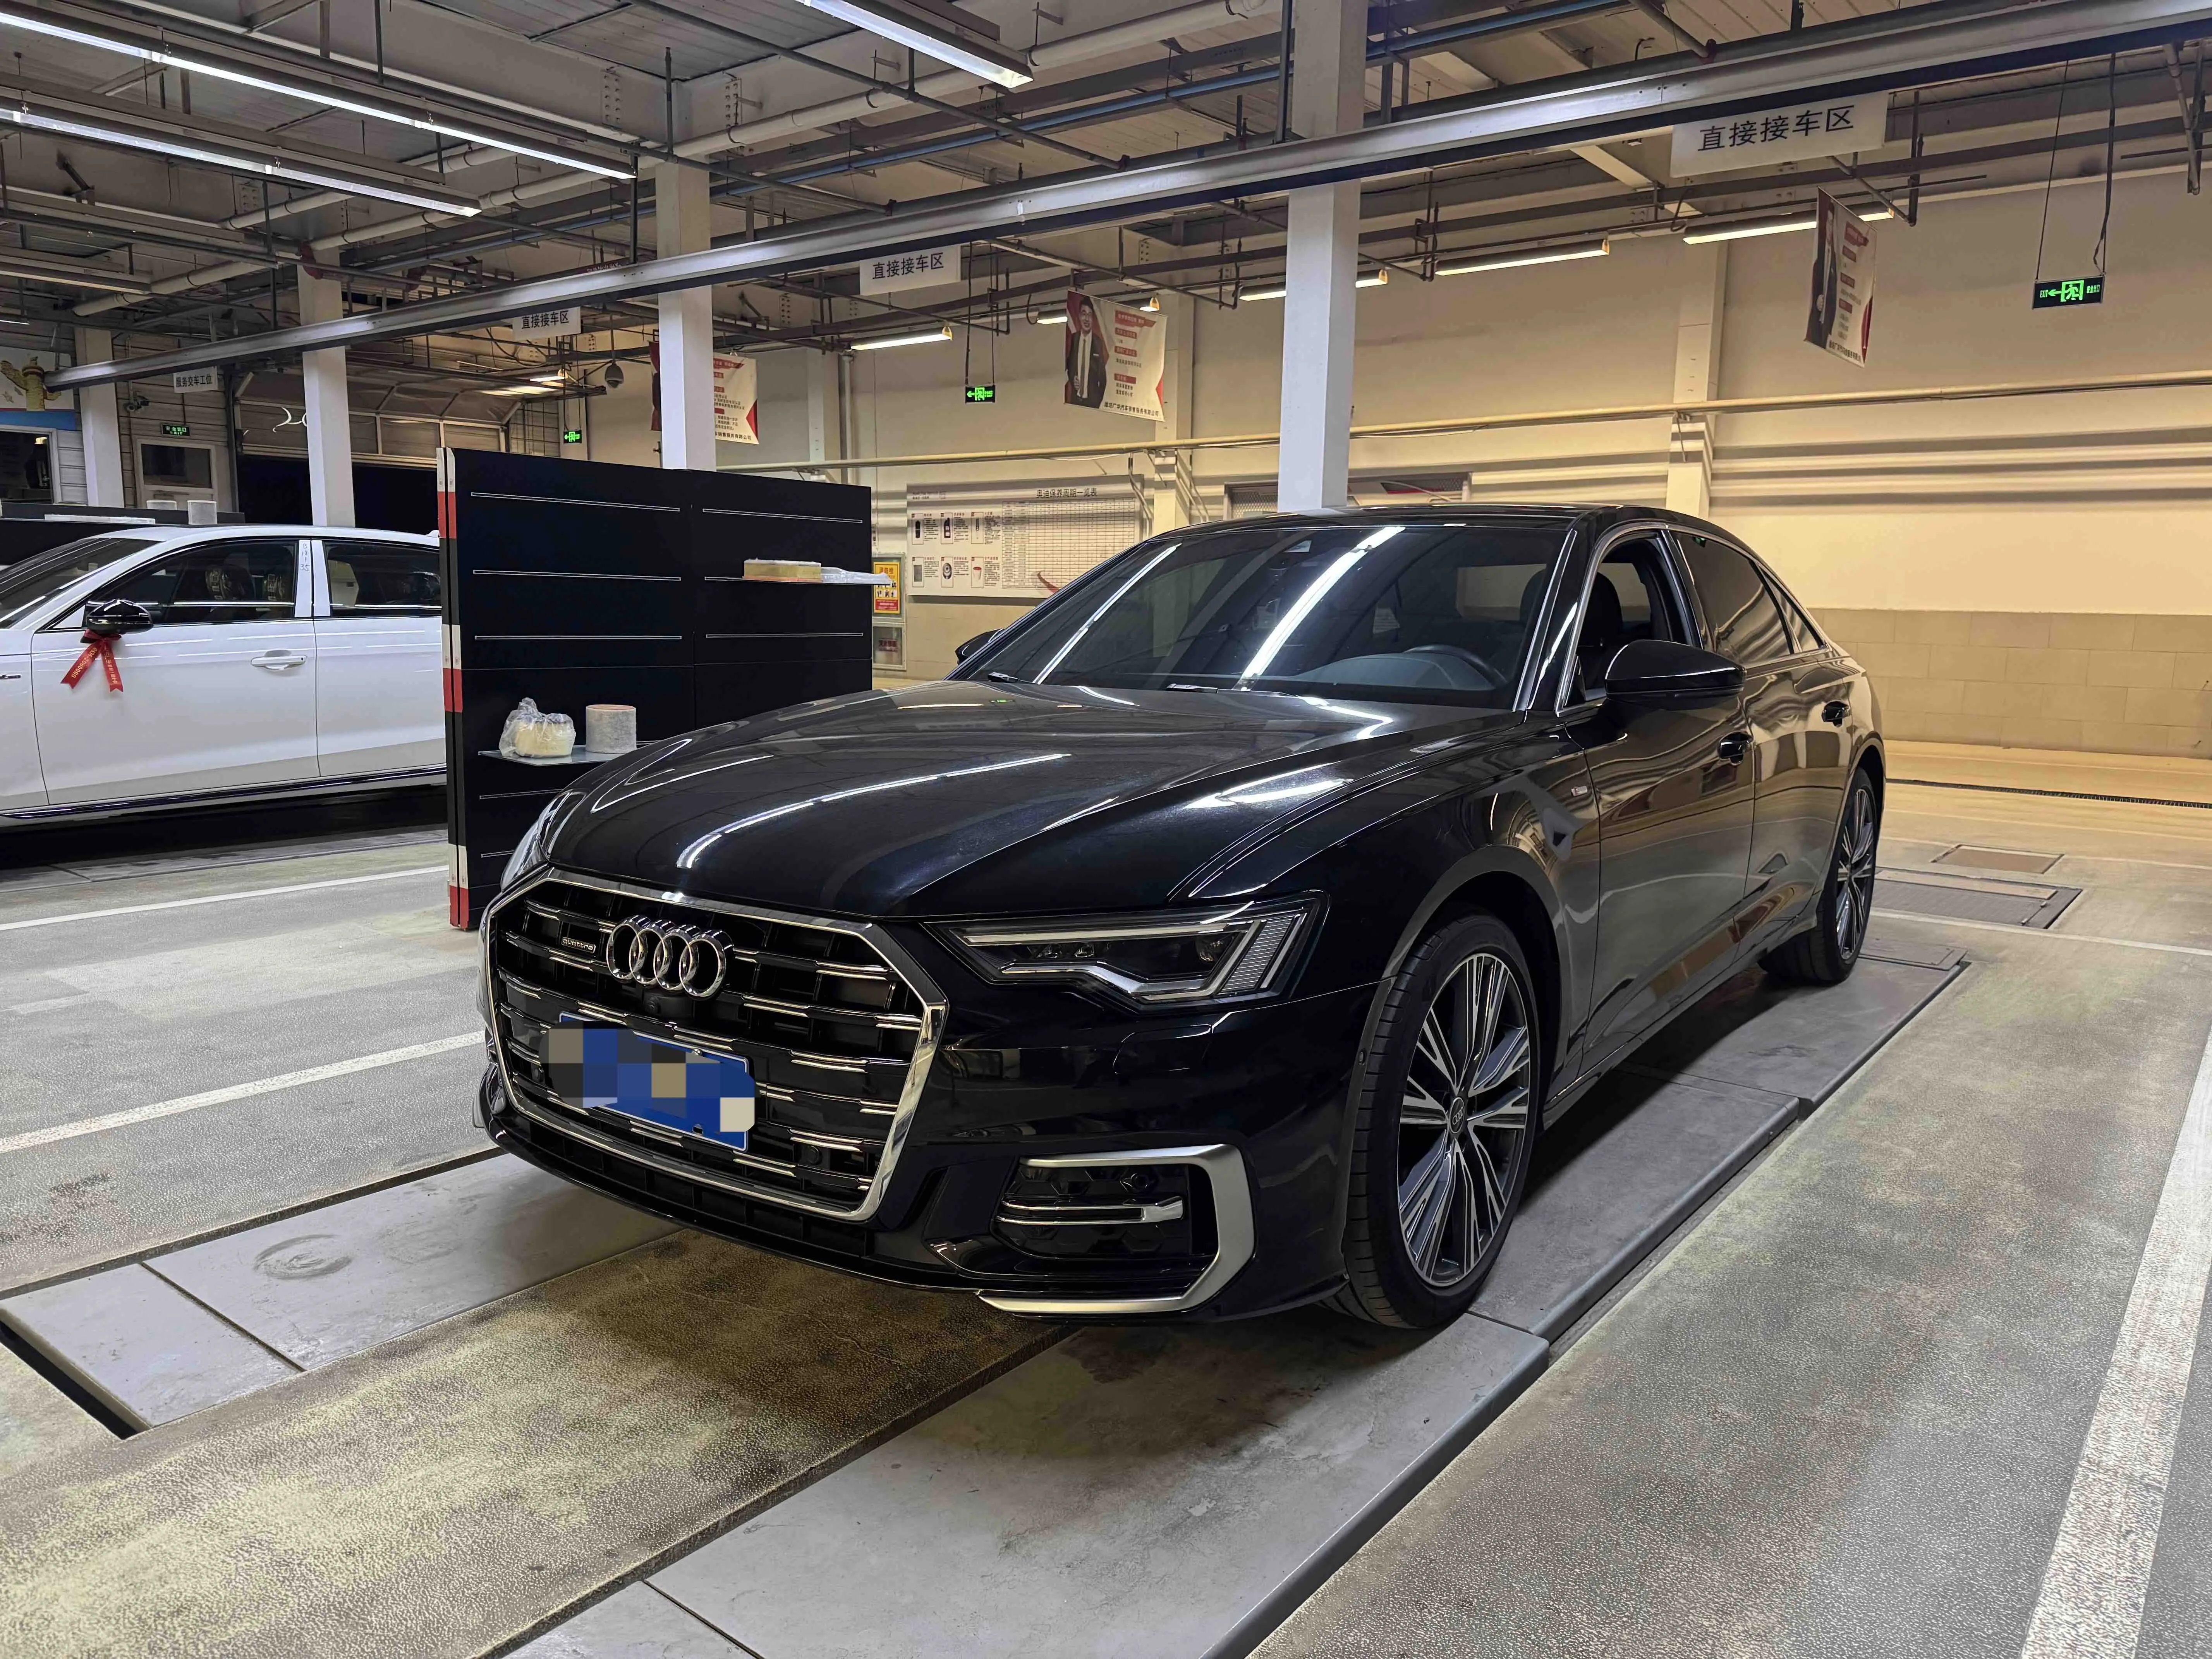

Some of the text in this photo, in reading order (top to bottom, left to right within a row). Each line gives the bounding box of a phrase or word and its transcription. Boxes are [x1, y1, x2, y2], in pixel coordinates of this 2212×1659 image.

[1698, 105, 1855, 151] 直接接车区
[872, 252, 944, 279] 直接接车区
[2040, 290, 2048, 298] EXIT
[521, 310, 569, 329] 直接接车区
[176, 374, 213, 387] 服务交车工位
[1036, 488, 1097, 498] 奥迪保养周期一览表
[563, 939, 593, 950] quattro
